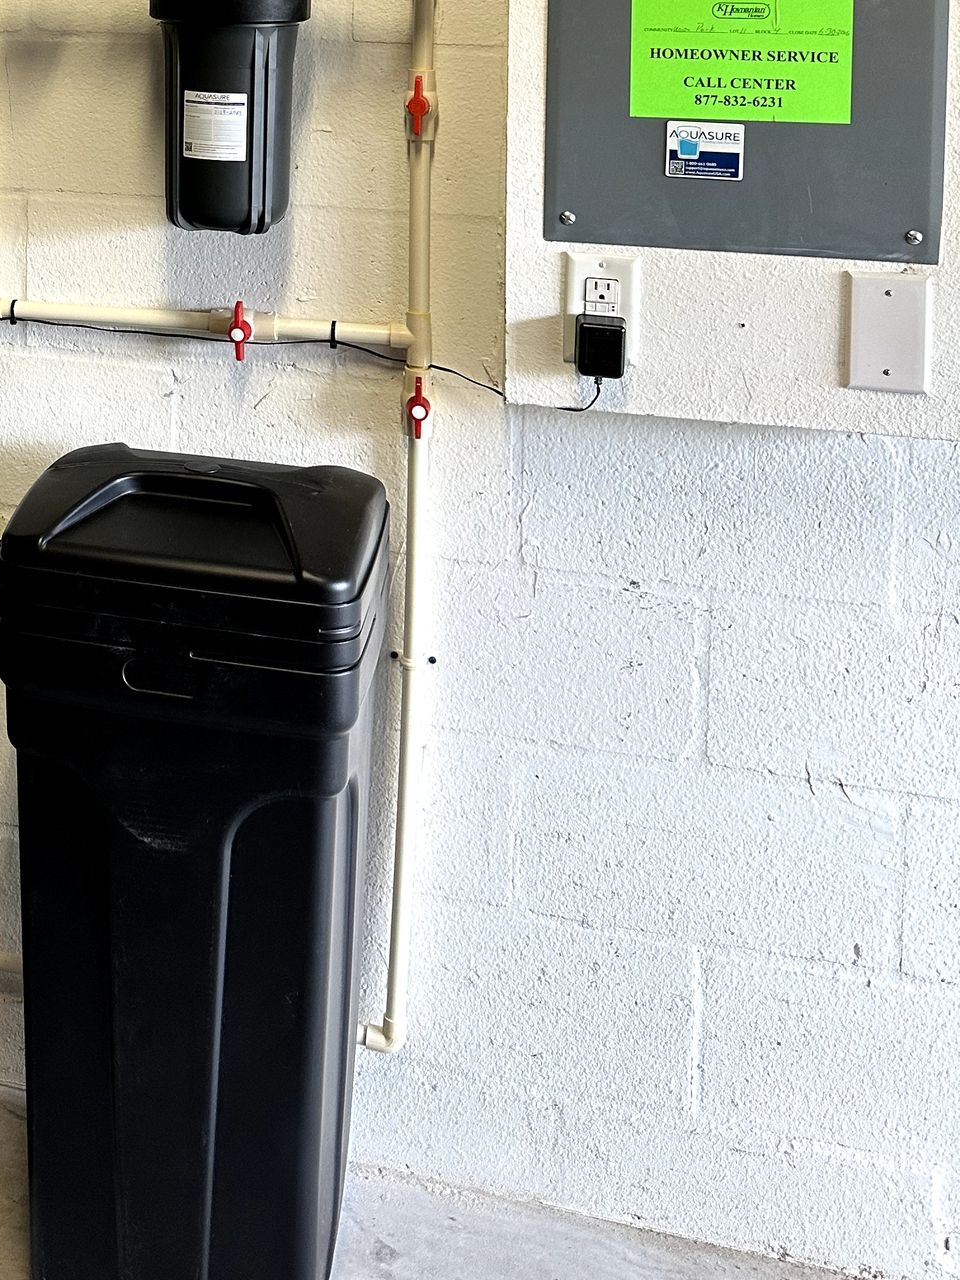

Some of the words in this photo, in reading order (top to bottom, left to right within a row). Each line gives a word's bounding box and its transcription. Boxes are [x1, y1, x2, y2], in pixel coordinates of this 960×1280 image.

[650, 48, 763, 62] HOMEOWNER
[767, 51, 839, 63] SERVICE
[683, 76, 727, 89] CALL
[730, 78, 796, 91] CENTER
[694, 94, 783, 108] 877-832-6231
[669, 130, 741, 142] AQUASURE
